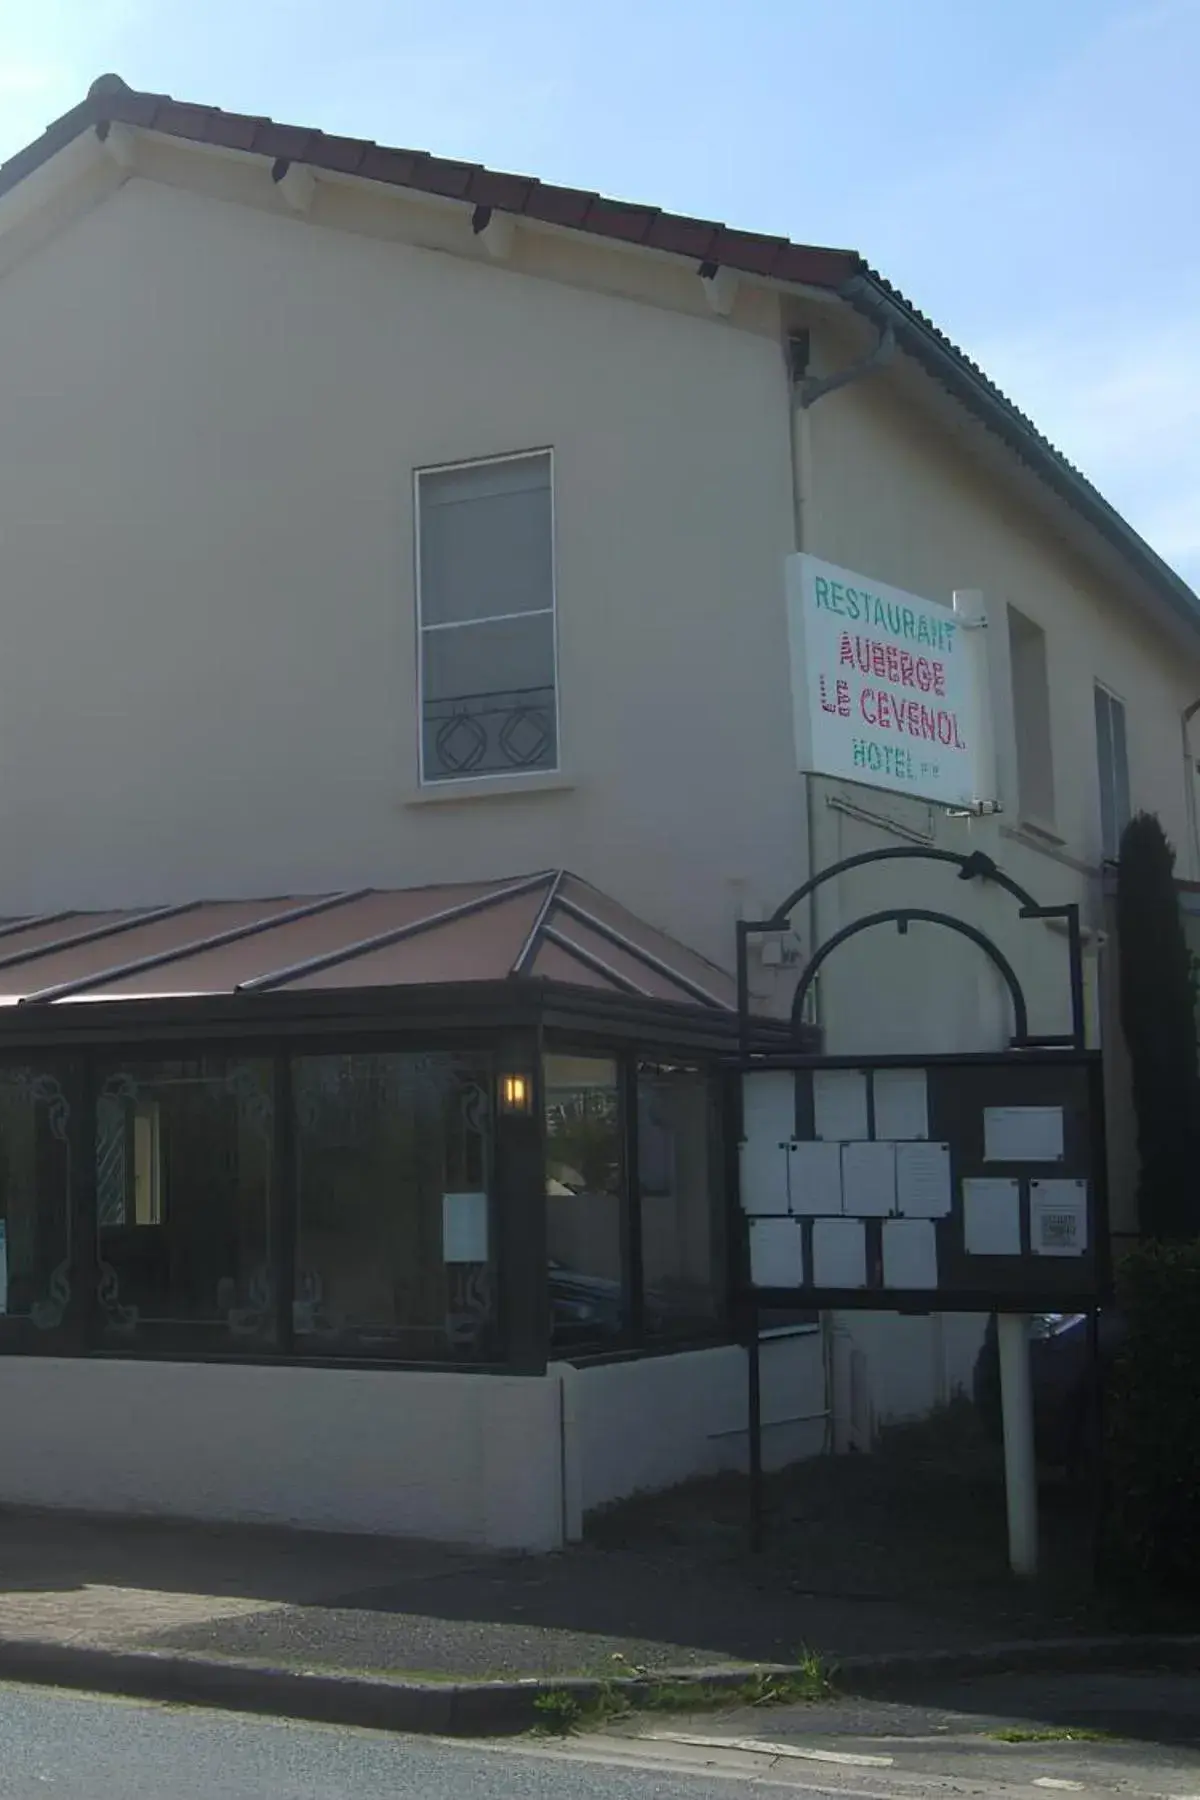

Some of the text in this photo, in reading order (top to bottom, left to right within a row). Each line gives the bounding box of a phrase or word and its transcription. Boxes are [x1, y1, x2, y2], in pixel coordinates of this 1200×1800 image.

[815, 576, 956, 653] RESTAURANT
[840, 631, 945, 697] AUBERGE
[820, 675, 851, 718] LE
[852, 739, 917, 779] HOTEL
